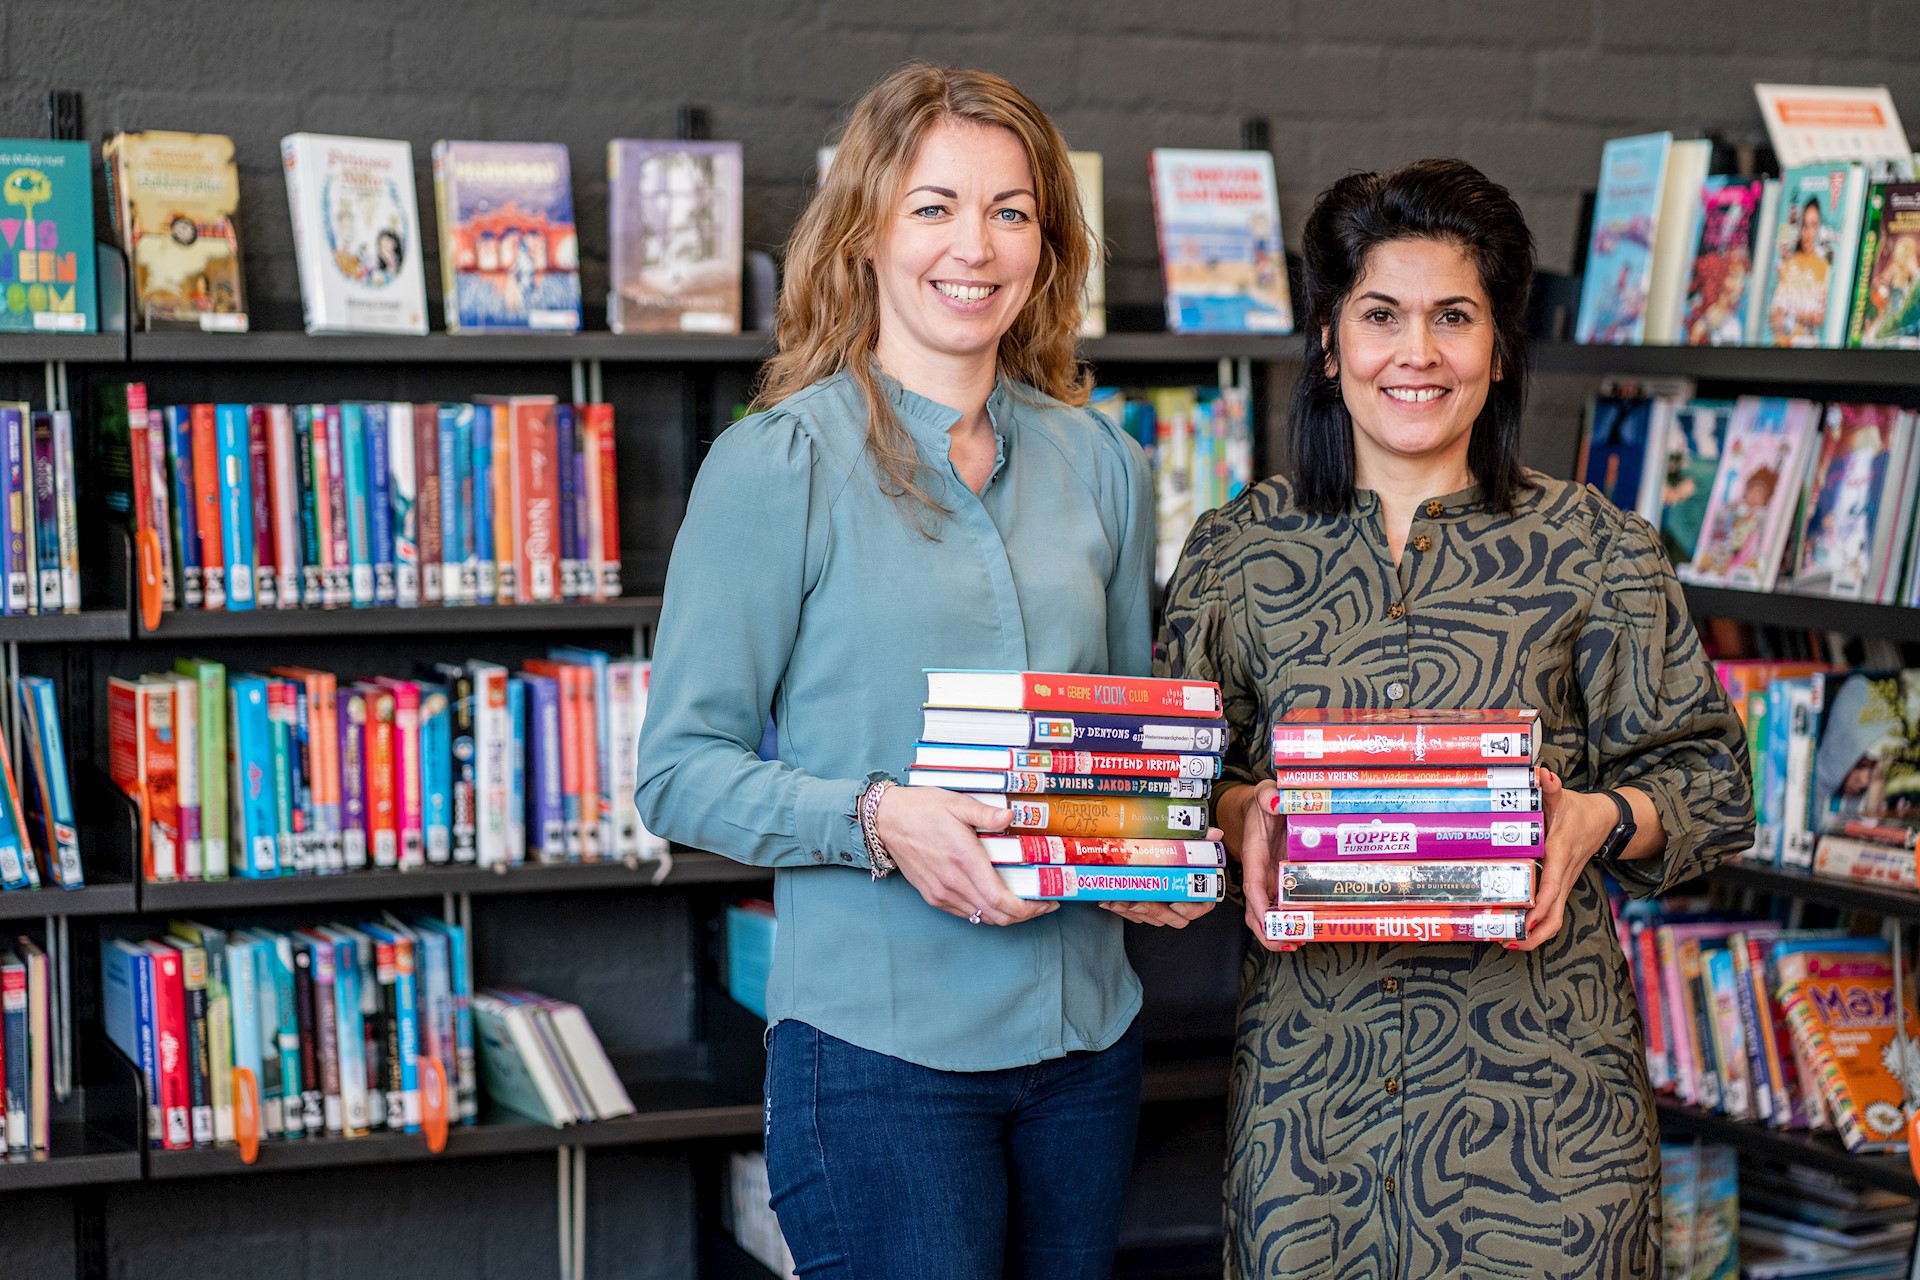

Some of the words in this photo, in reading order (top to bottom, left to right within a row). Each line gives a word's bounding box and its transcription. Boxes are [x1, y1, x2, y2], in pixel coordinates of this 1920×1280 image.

[0, 218, 58, 249] VIS
[19, 250, 76, 283] EEN
[1058, 687, 1065, 696] DE
[1067, 685, 1091, 700] GEHEIME
[1094, 685, 1127, 705] KOOK
[1128, 690, 1148, 702] CLUB
[1088, 727, 1130, 740] DENTONS
[1284, 772, 1324, 782] JACQUES
[1327, 772, 1359, 781] VRIENS
[1382, 771, 1409, 780] vader
[1414, 772, 1440, 780] woont
[1028, 774, 1036, 792] 2022
[1058, 778, 1094, 789] VRIENS
[1098, 781, 1131, 792] JAKOB
[1139, 780, 1147, 793] 7
[1031, 808, 1039, 824] 2022
[1054, 802, 1110, 818] WARRIOR
[1064, 816, 1098, 832] CATS
[1344, 831, 1410, 845] TOPPER
[1436, 832, 1462, 841] DAVID
[1132, 846, 1178, 858] noodgeval
[1344, 844, 1410, 852] TURBORACER
[1162, 877, 1168, 889] 1
[1333, 882, 1392, 894] APOLLO
